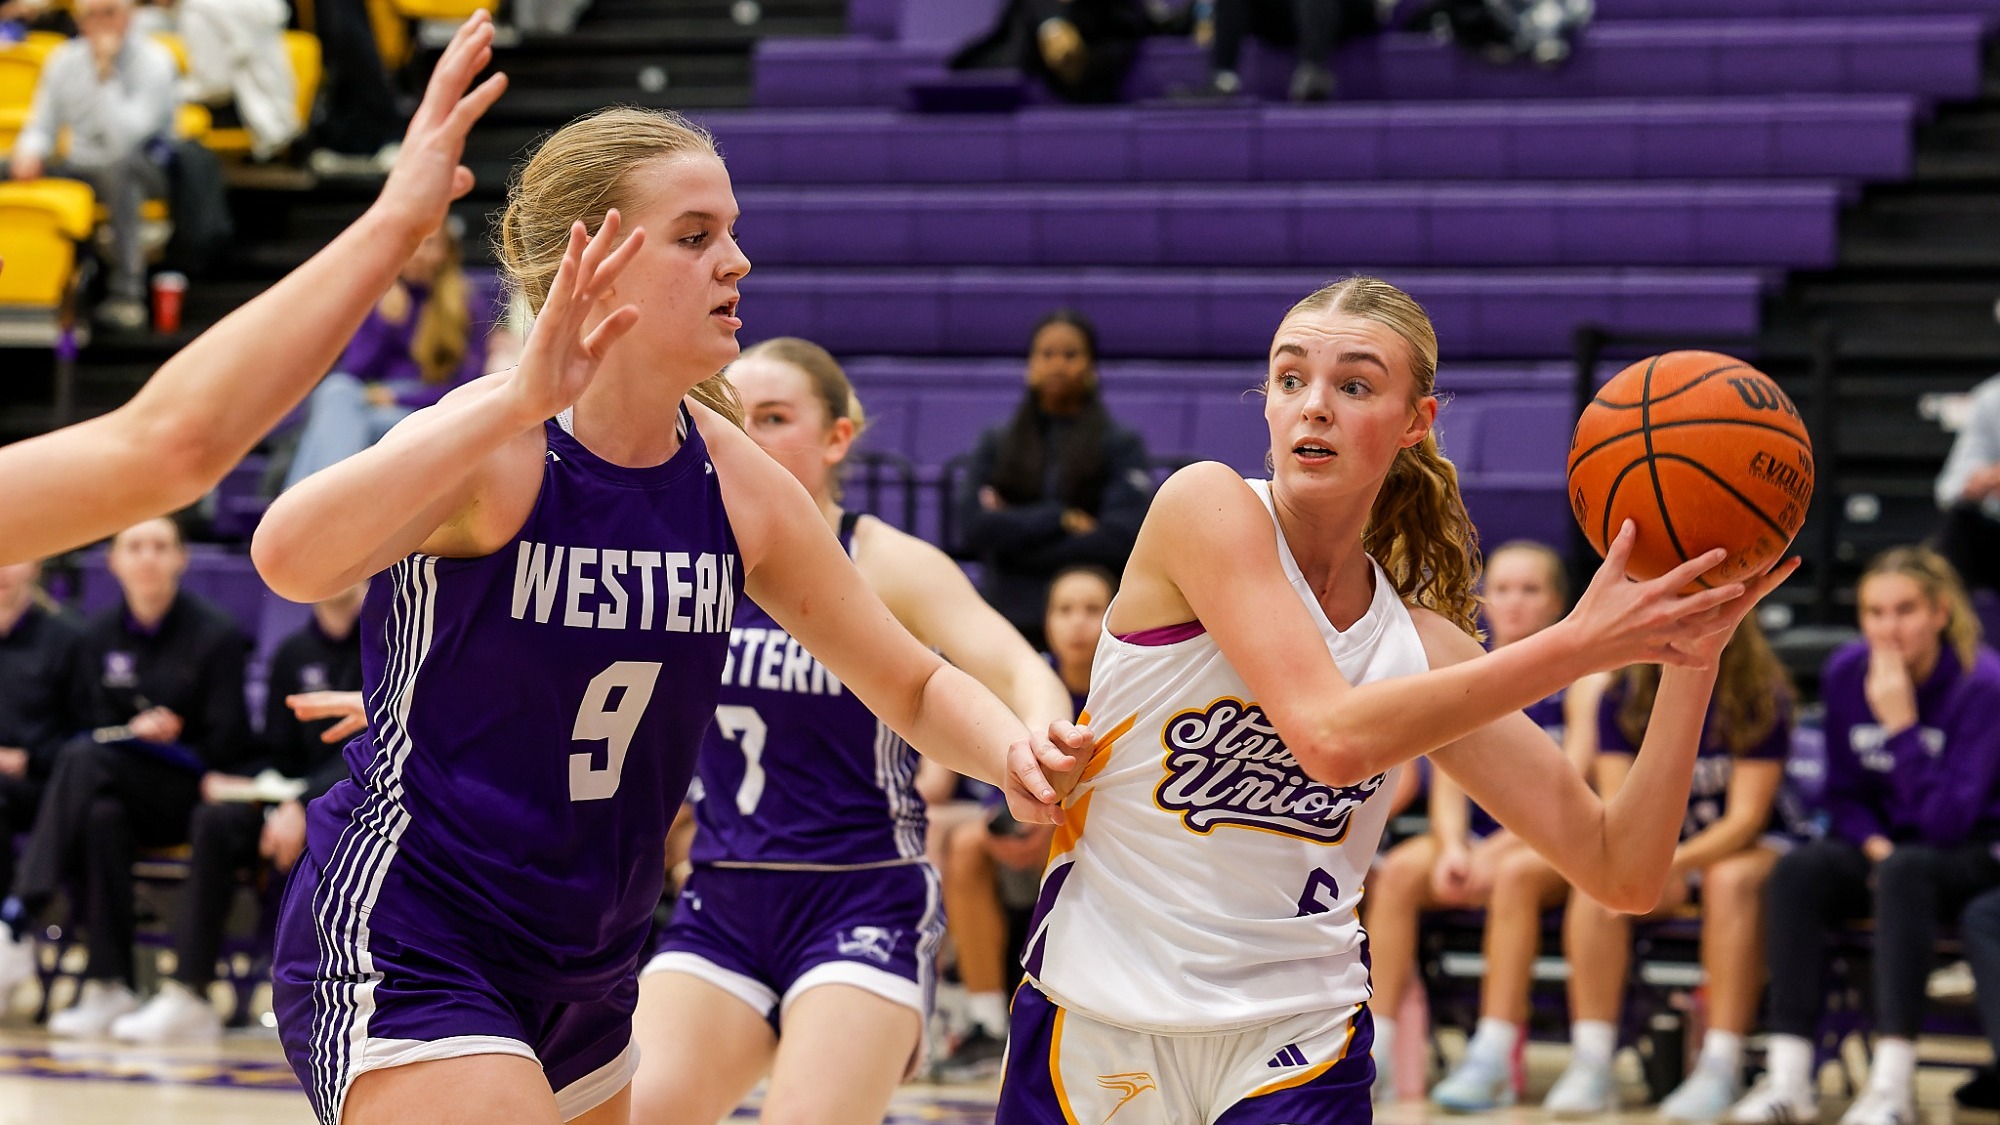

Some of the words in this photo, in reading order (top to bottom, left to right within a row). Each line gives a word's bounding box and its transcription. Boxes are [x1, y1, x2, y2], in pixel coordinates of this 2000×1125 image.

[511, 540, 735, 633] WESTERN
[721, 627, 842, 696] STERN
[569, 660, 663, 802] 9
[1162, 753, 1363, 820] Union
